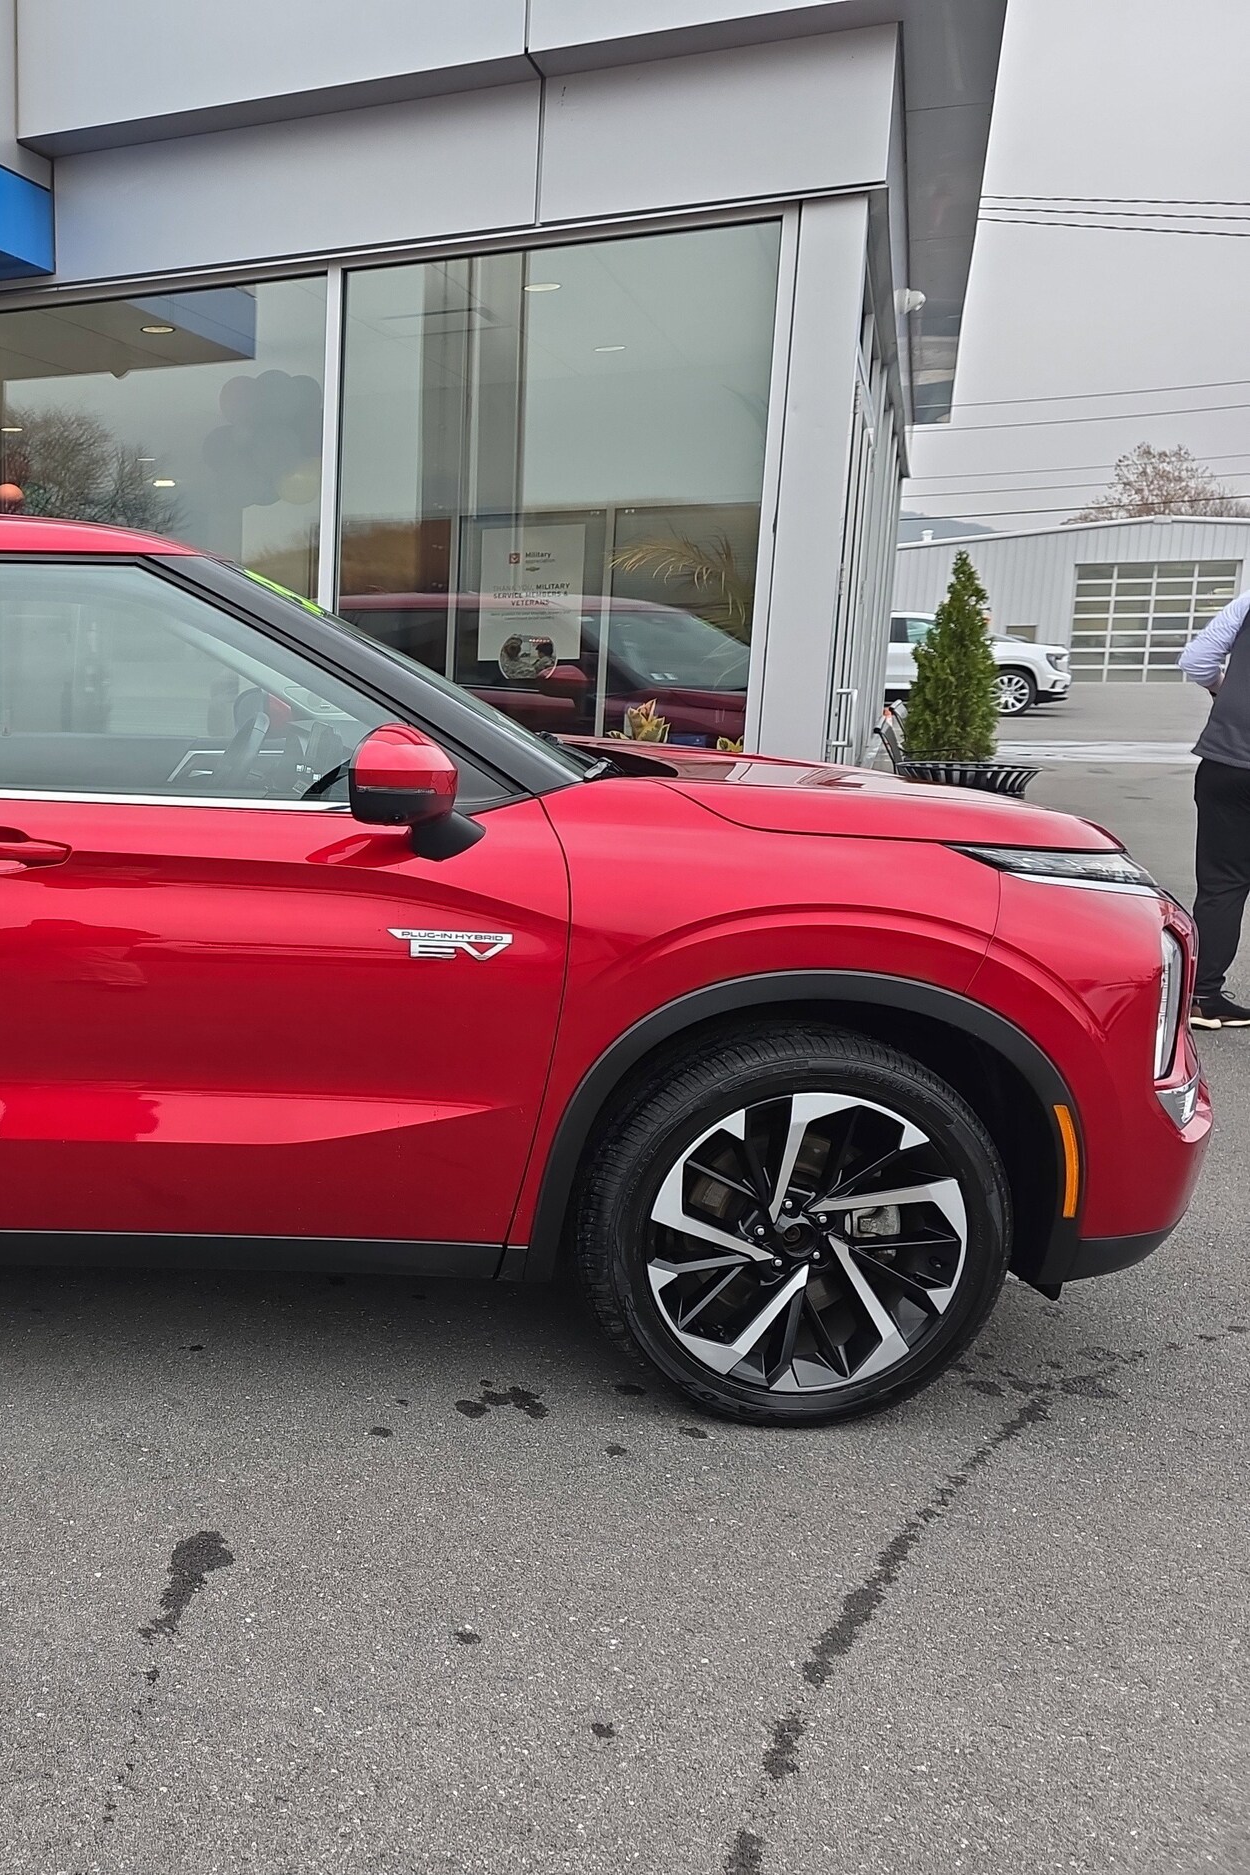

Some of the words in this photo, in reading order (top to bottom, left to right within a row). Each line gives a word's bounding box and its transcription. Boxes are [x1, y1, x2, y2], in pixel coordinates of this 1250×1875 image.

[401, 930, 453, 940] PLUG-IN
[455, 934, 504, 942] HYBRID
[410, 940, 511, 961] EV
